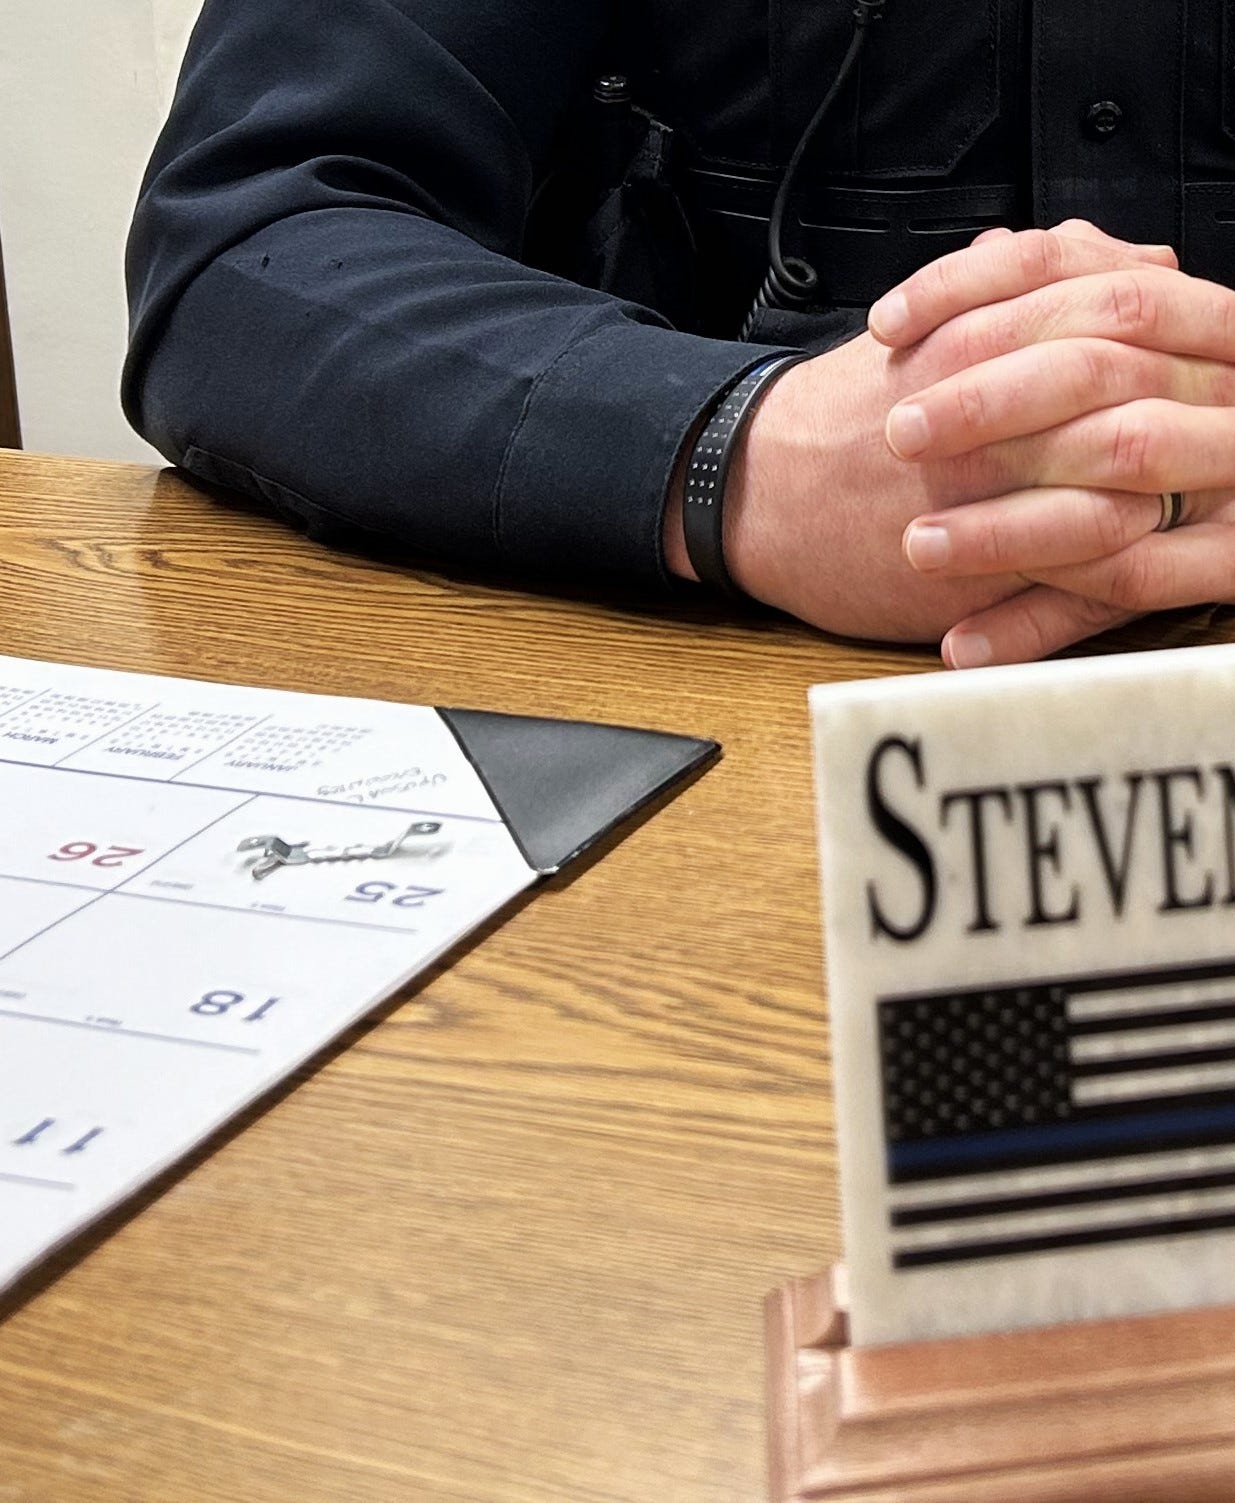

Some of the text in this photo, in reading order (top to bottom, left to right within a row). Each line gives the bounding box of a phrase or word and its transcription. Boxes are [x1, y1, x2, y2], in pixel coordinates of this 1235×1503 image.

[3, 731, 59, 744] MARCH
[104, 745, 185, 760] FEBRUARY
[48, 839, 145, 869] 26
[344, 879, 445, 908] 25
[188, 988, 281, 1023] 18
[12, 1117, 106, 1155] 11
